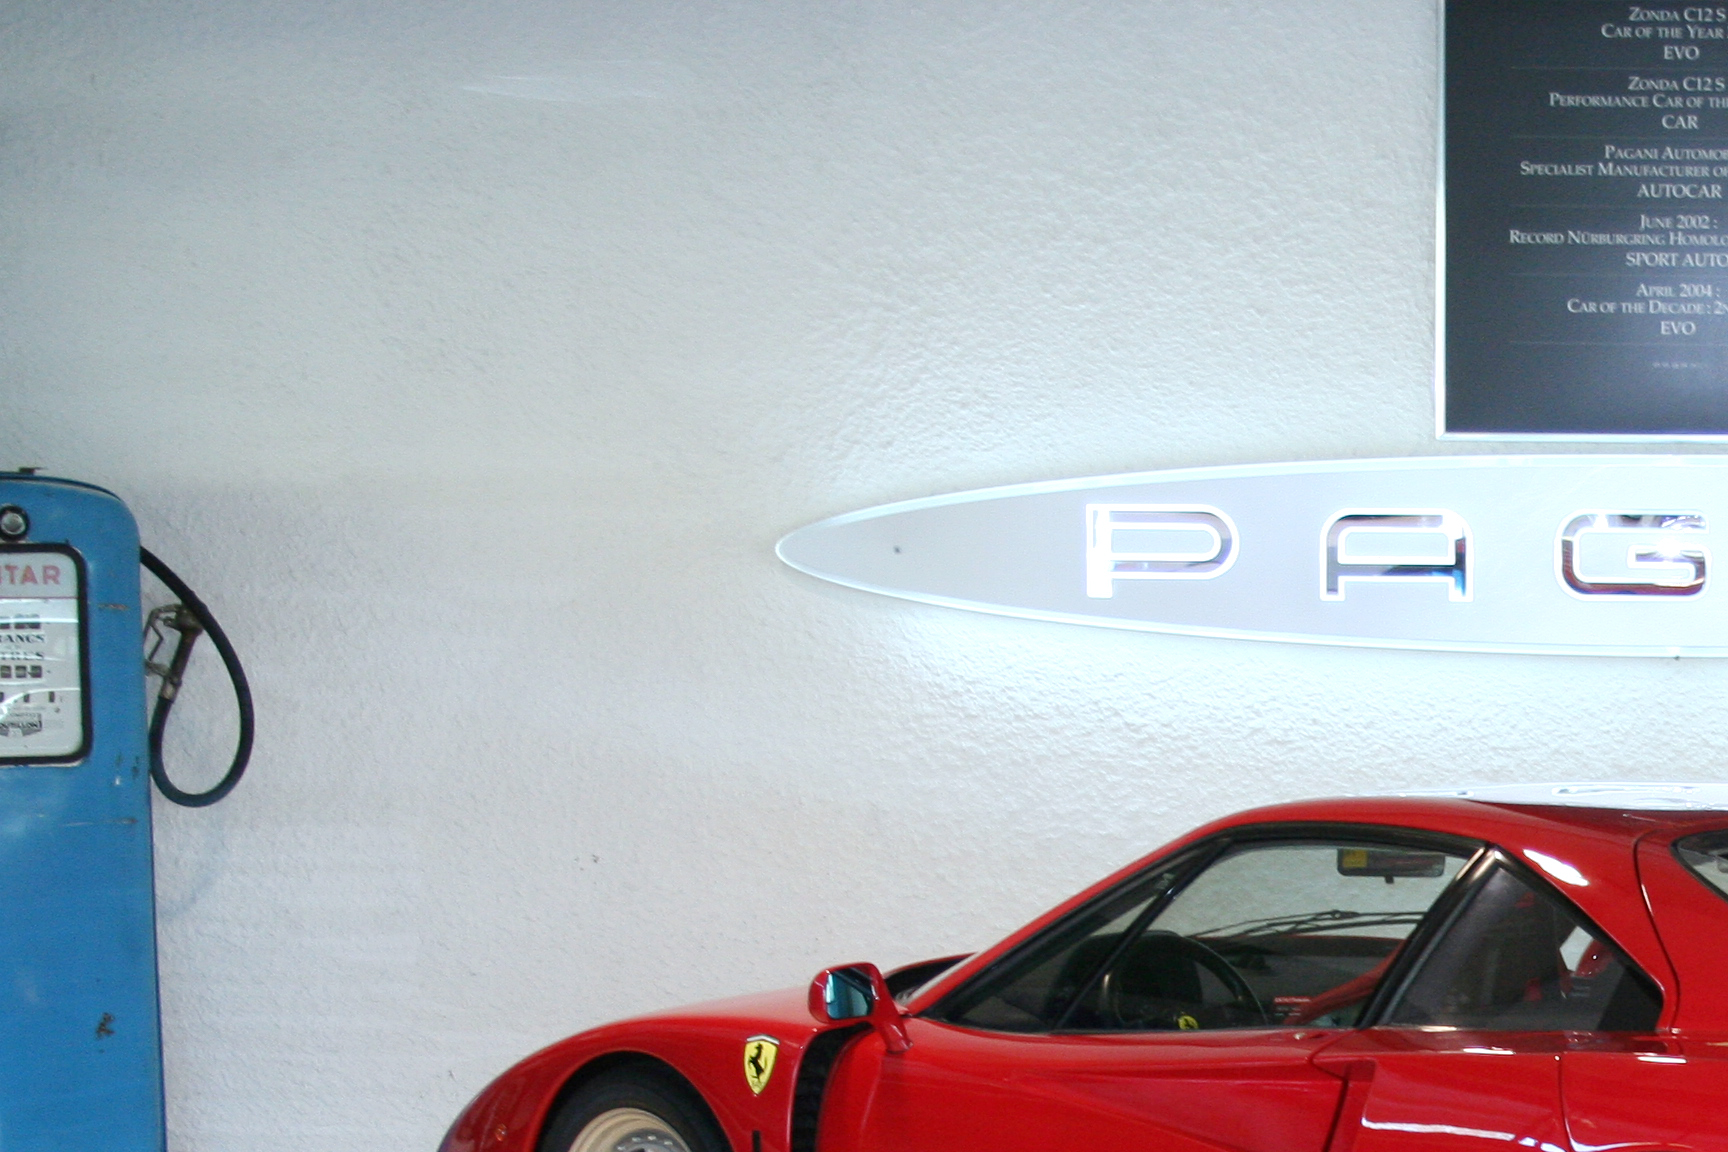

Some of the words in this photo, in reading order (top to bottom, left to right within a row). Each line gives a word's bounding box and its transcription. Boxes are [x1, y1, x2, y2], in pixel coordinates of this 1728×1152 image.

[1628, 6, 1681, 22] ZONDA
[1682, 6, 1714, 23] C12
[1715, 7, 1727, 23] S
[1600, 22, 1633, 39] CAR
[1634, 26, 1654, 39] OF
[1656, 26, 1683, 39] THE
[1685, 23, 1725, 40] YEAR
[1663, 44, 1701, 61] EVO
[1627, 75, 1680, 91] ZONDA
[1682, 76, 1713, 92] C12
[1714, 76, 1726, 92] S
[1548, 91, 1649, 108] PERFORMANCE
[1651, 93, 1684, 109] CAR
[1685, 96, 1704, 109] OF
[1661, 114, 1699, 130] CAR
[1604, 144, 1659, 160] PAGANI
[1519, 160, 1595, 177] SPECIALIST
[1597, 161, 1710, 177] MANUFACTURER
[1636, 183, 1723, 199] AUTOCAR
[1638, 213, 1674, 231] JUNE
[1675, 214, 1712, 230] 2002
[1508, 228, 1566, 245] RECORD
[1625, 251, 1679, 267] SPORT
[1635, 282, 1676, 298] APRIL
[1678, 283, 1714, 298] 2004
[1566, 297, 1598, 314] CAR
[1599, 301, 1618, 314] OF
[1620, 301, 1646, 314] THE
[1648, 299, 1704, 315] DECADE
[1660, 320, 1697, 336] EVO
[0, 565, 61, 585] TAR
